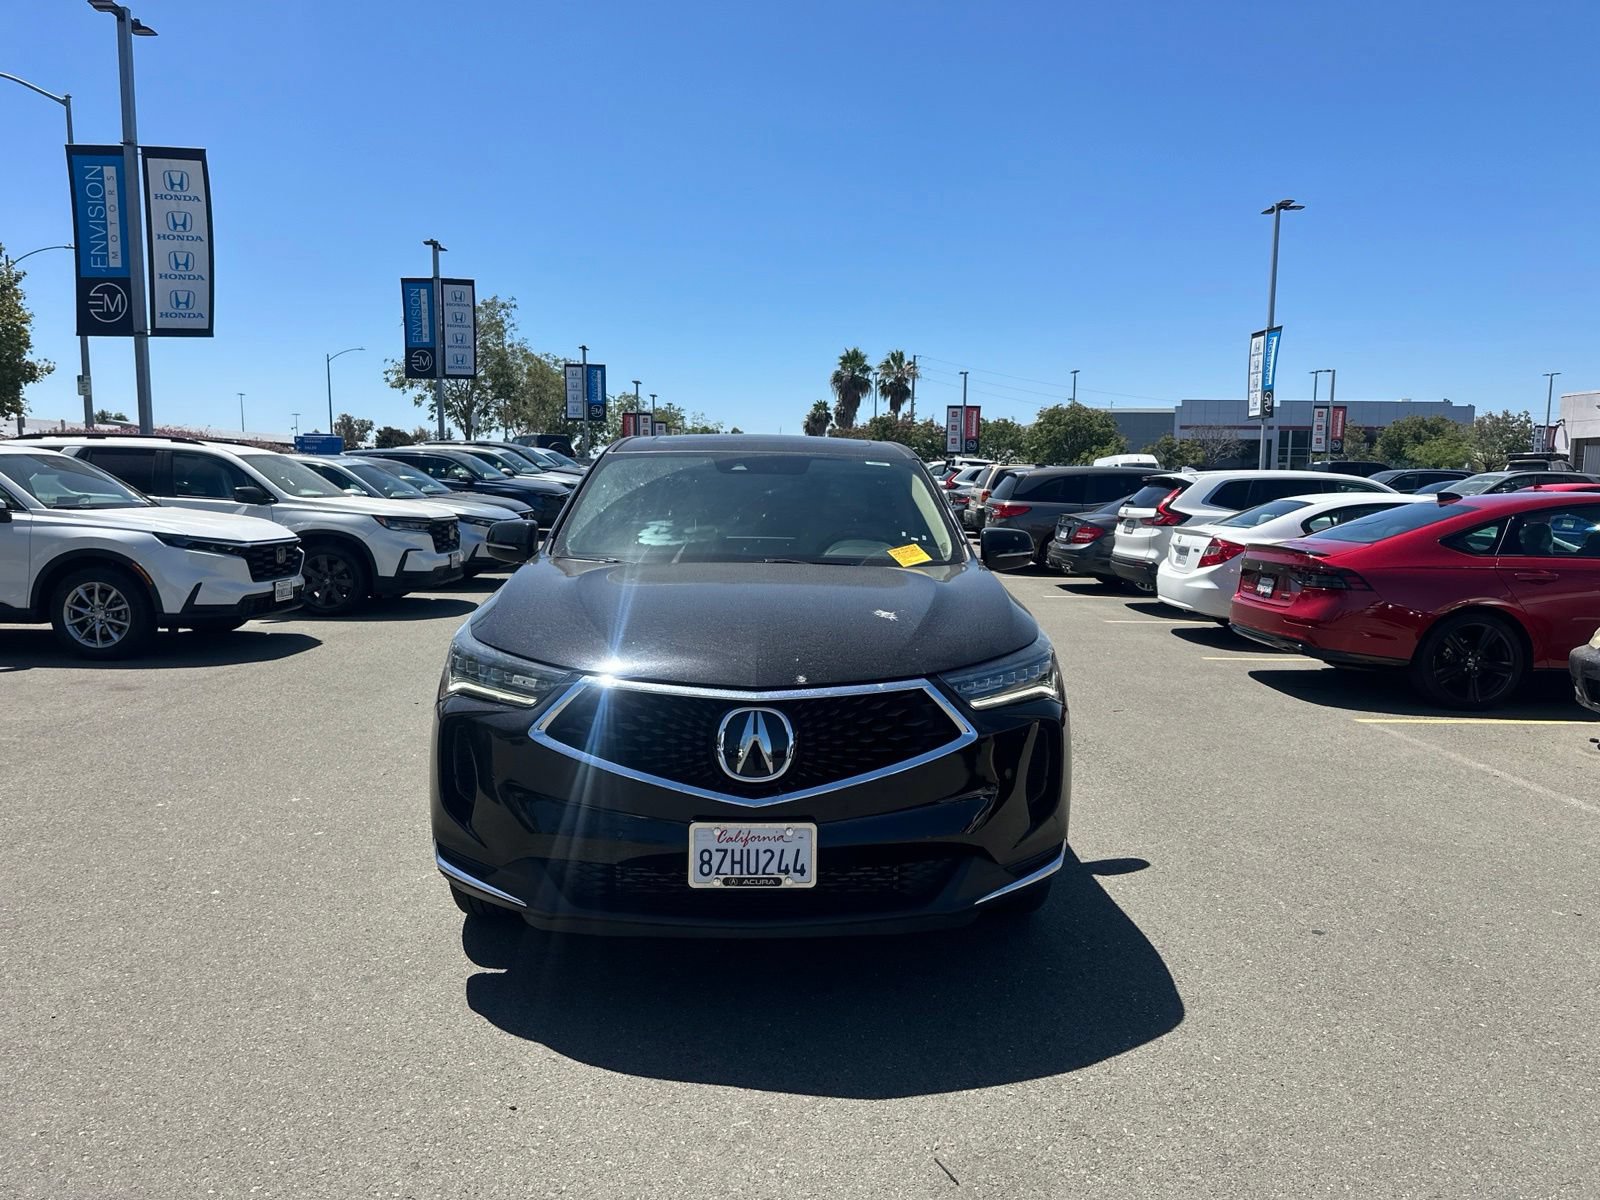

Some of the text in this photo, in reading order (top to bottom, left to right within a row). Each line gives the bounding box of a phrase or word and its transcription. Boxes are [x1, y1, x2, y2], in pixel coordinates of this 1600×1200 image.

[154, 193, 202, 202] HONDA
[84, 165, 107, 269] ENVISION
[106, 175, 119, 260] MOTORS
[156, 233, 204, 242] HONDA
[158, 273, 206, 281] HONDA
[159, 311, 205, 319] HONDA
[410, 288, 423, 343] ENVISION
[717, 829, 792, 848] California
[699, 848, 806, 877] 8ZHU244
[742, 878, 776, 886] ACURA
